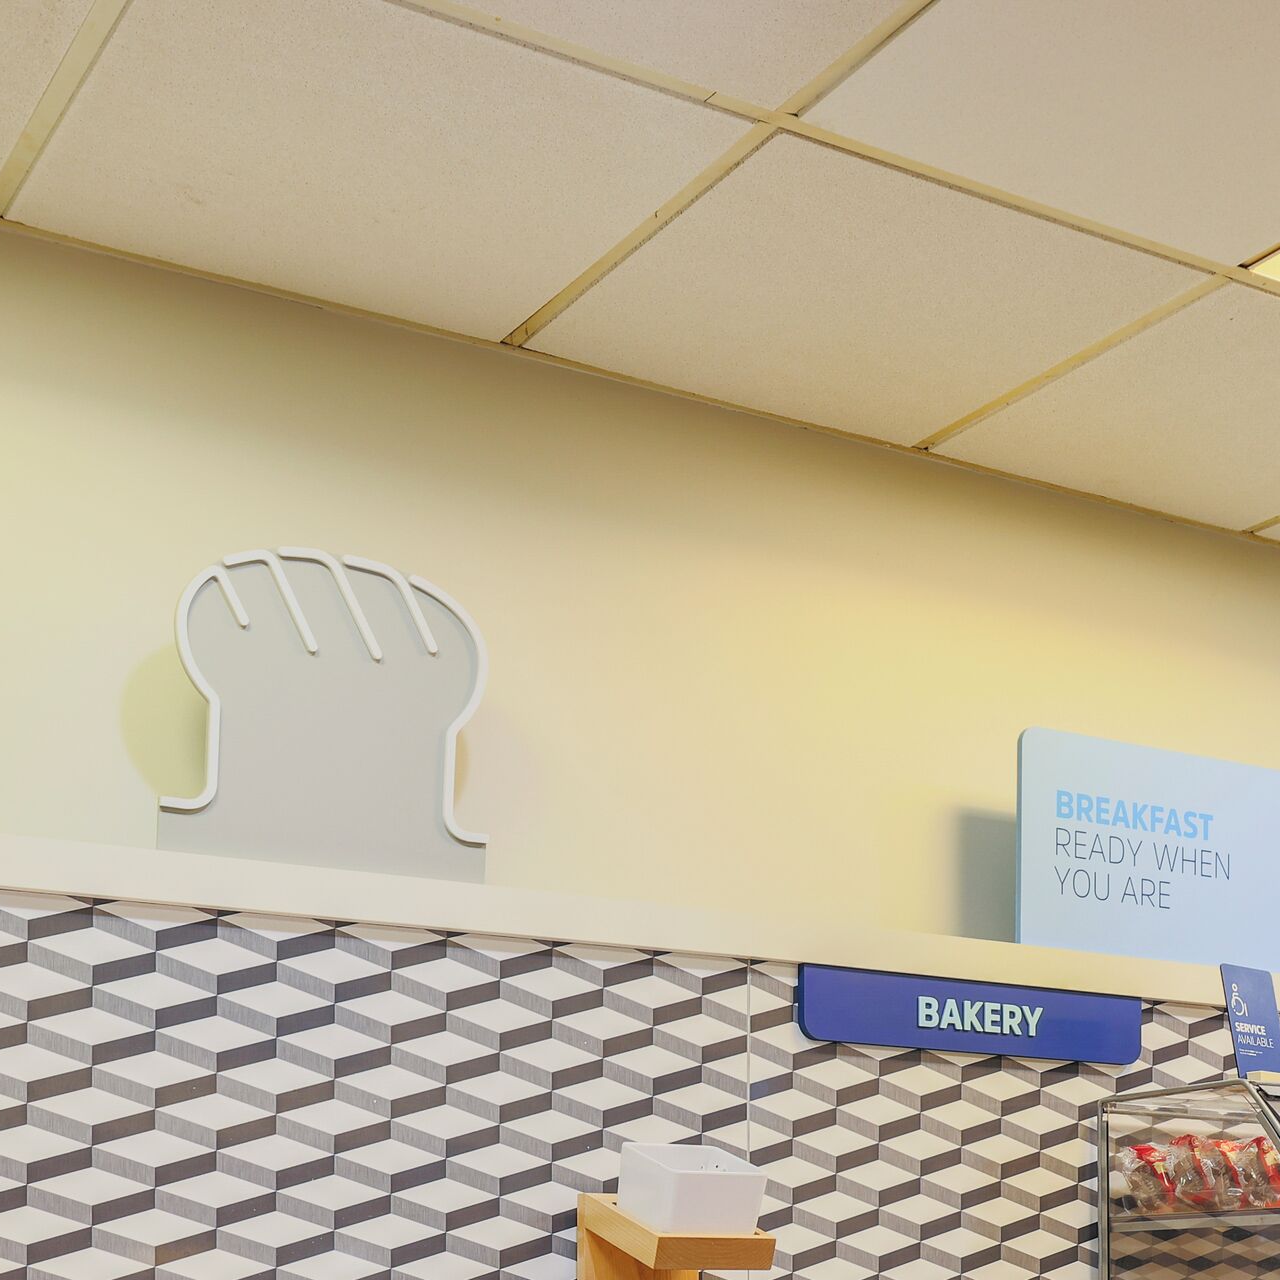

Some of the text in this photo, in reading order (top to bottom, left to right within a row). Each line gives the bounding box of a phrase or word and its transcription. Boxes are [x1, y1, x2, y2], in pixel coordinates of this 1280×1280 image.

[1055, 789, 1214, 841] BREAKFAST
[1055, 827, 1231, 880] READY WHEN
[1054, 865, 1171, 910] YOU ARE
[918, 995, 1043, 1037] BAKERY
[1235, 1021, 1267, 1036] SERVICE
[1237, 1034, 1274, 1048] AVAILABLE
